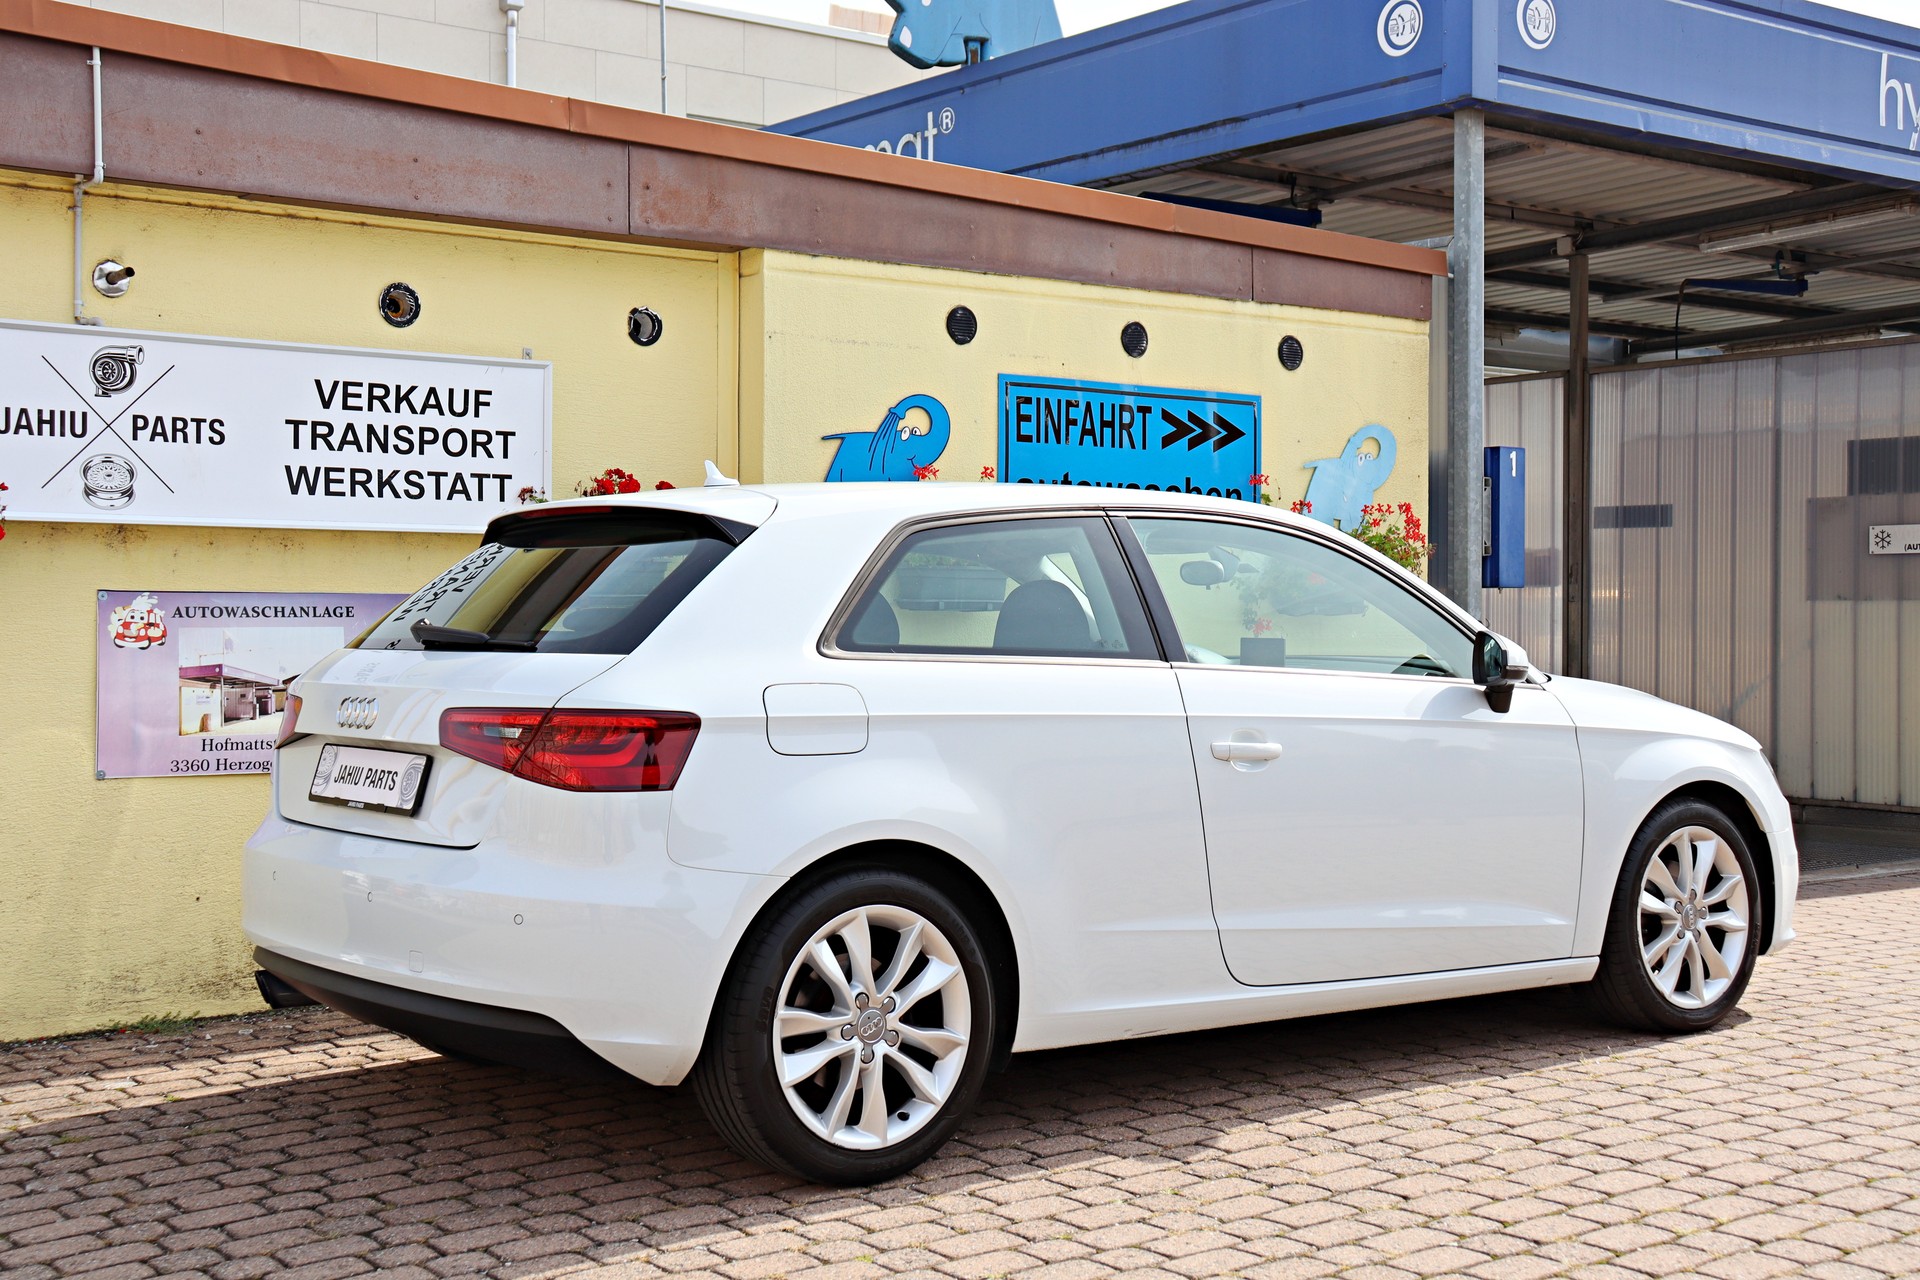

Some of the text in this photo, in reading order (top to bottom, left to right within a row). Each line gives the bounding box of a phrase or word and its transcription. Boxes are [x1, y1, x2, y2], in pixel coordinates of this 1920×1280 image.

[314, 378, 493, 418] VERKAUF
[0, 406, 226, 446] JAHIU PARTS
[285, 418, 516, 460] TRANSPORT
[1016, 395, 1152, 450] EINFAHRT
[1509, 450, 1517, 477] 1
[284, 464, 513, 502] WERKSTATT
[171, 605, 355, 619] AUTOWASCHANLAGE
[170, 758, 273, 773] 3360 Herzog
[334, 764, 398, 791] JAHIU PARTS
